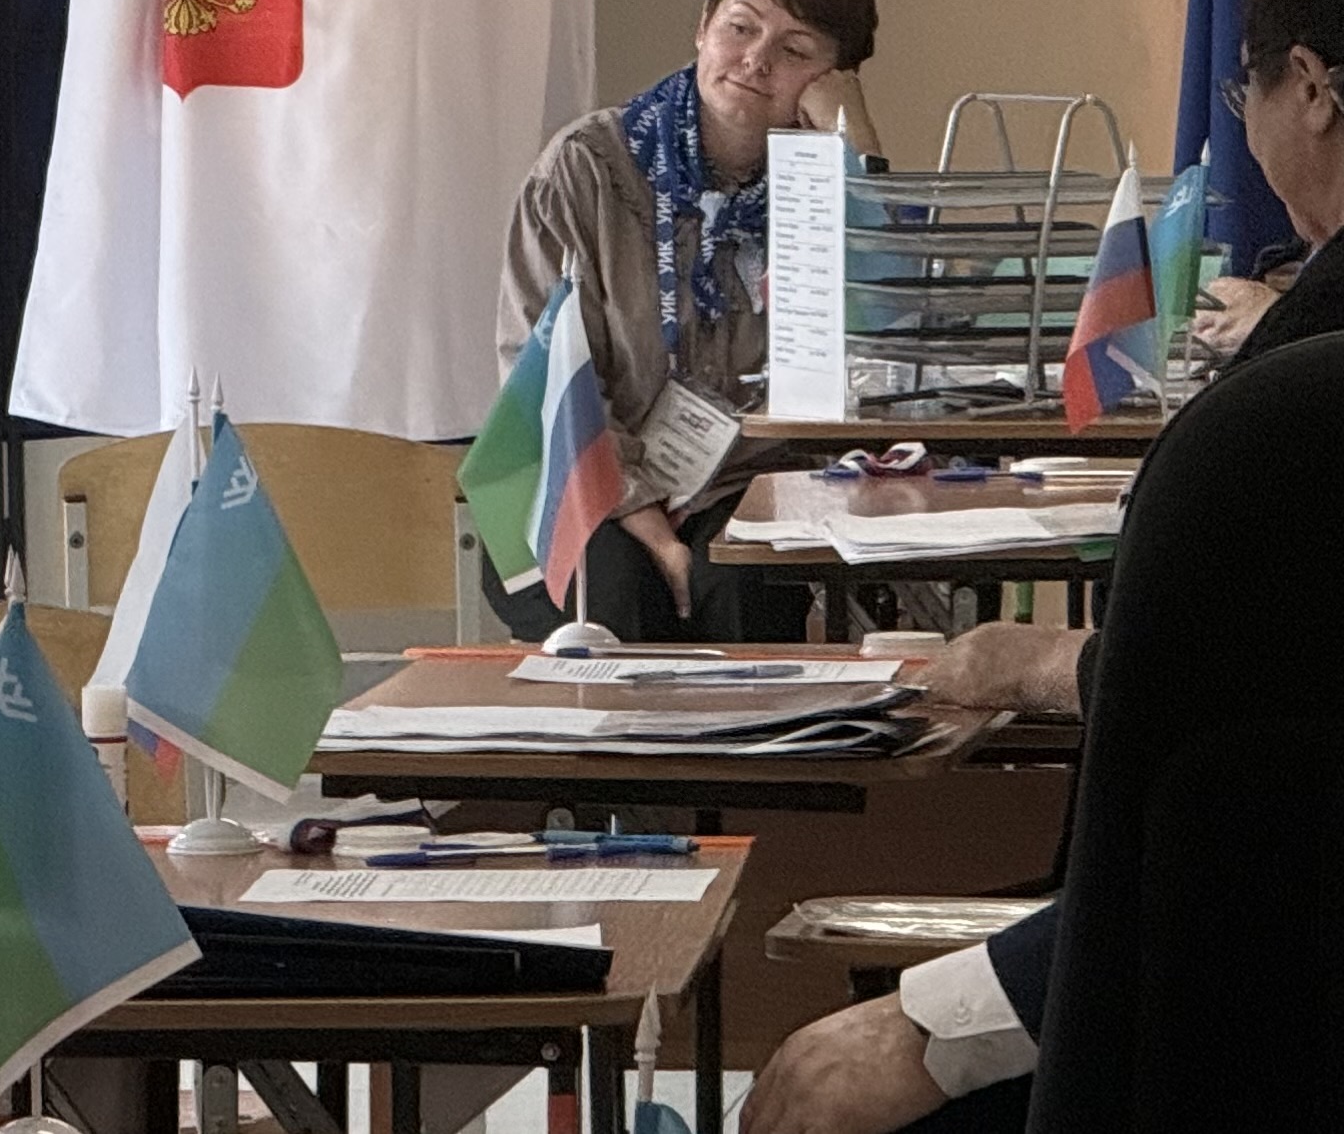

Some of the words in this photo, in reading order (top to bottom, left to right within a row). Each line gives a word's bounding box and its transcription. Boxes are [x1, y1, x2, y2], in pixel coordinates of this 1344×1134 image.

[656, 191, 673, 224] УИК
[656, 240, 675, 274] УИК
[660, 290, 677, 324] УИК
